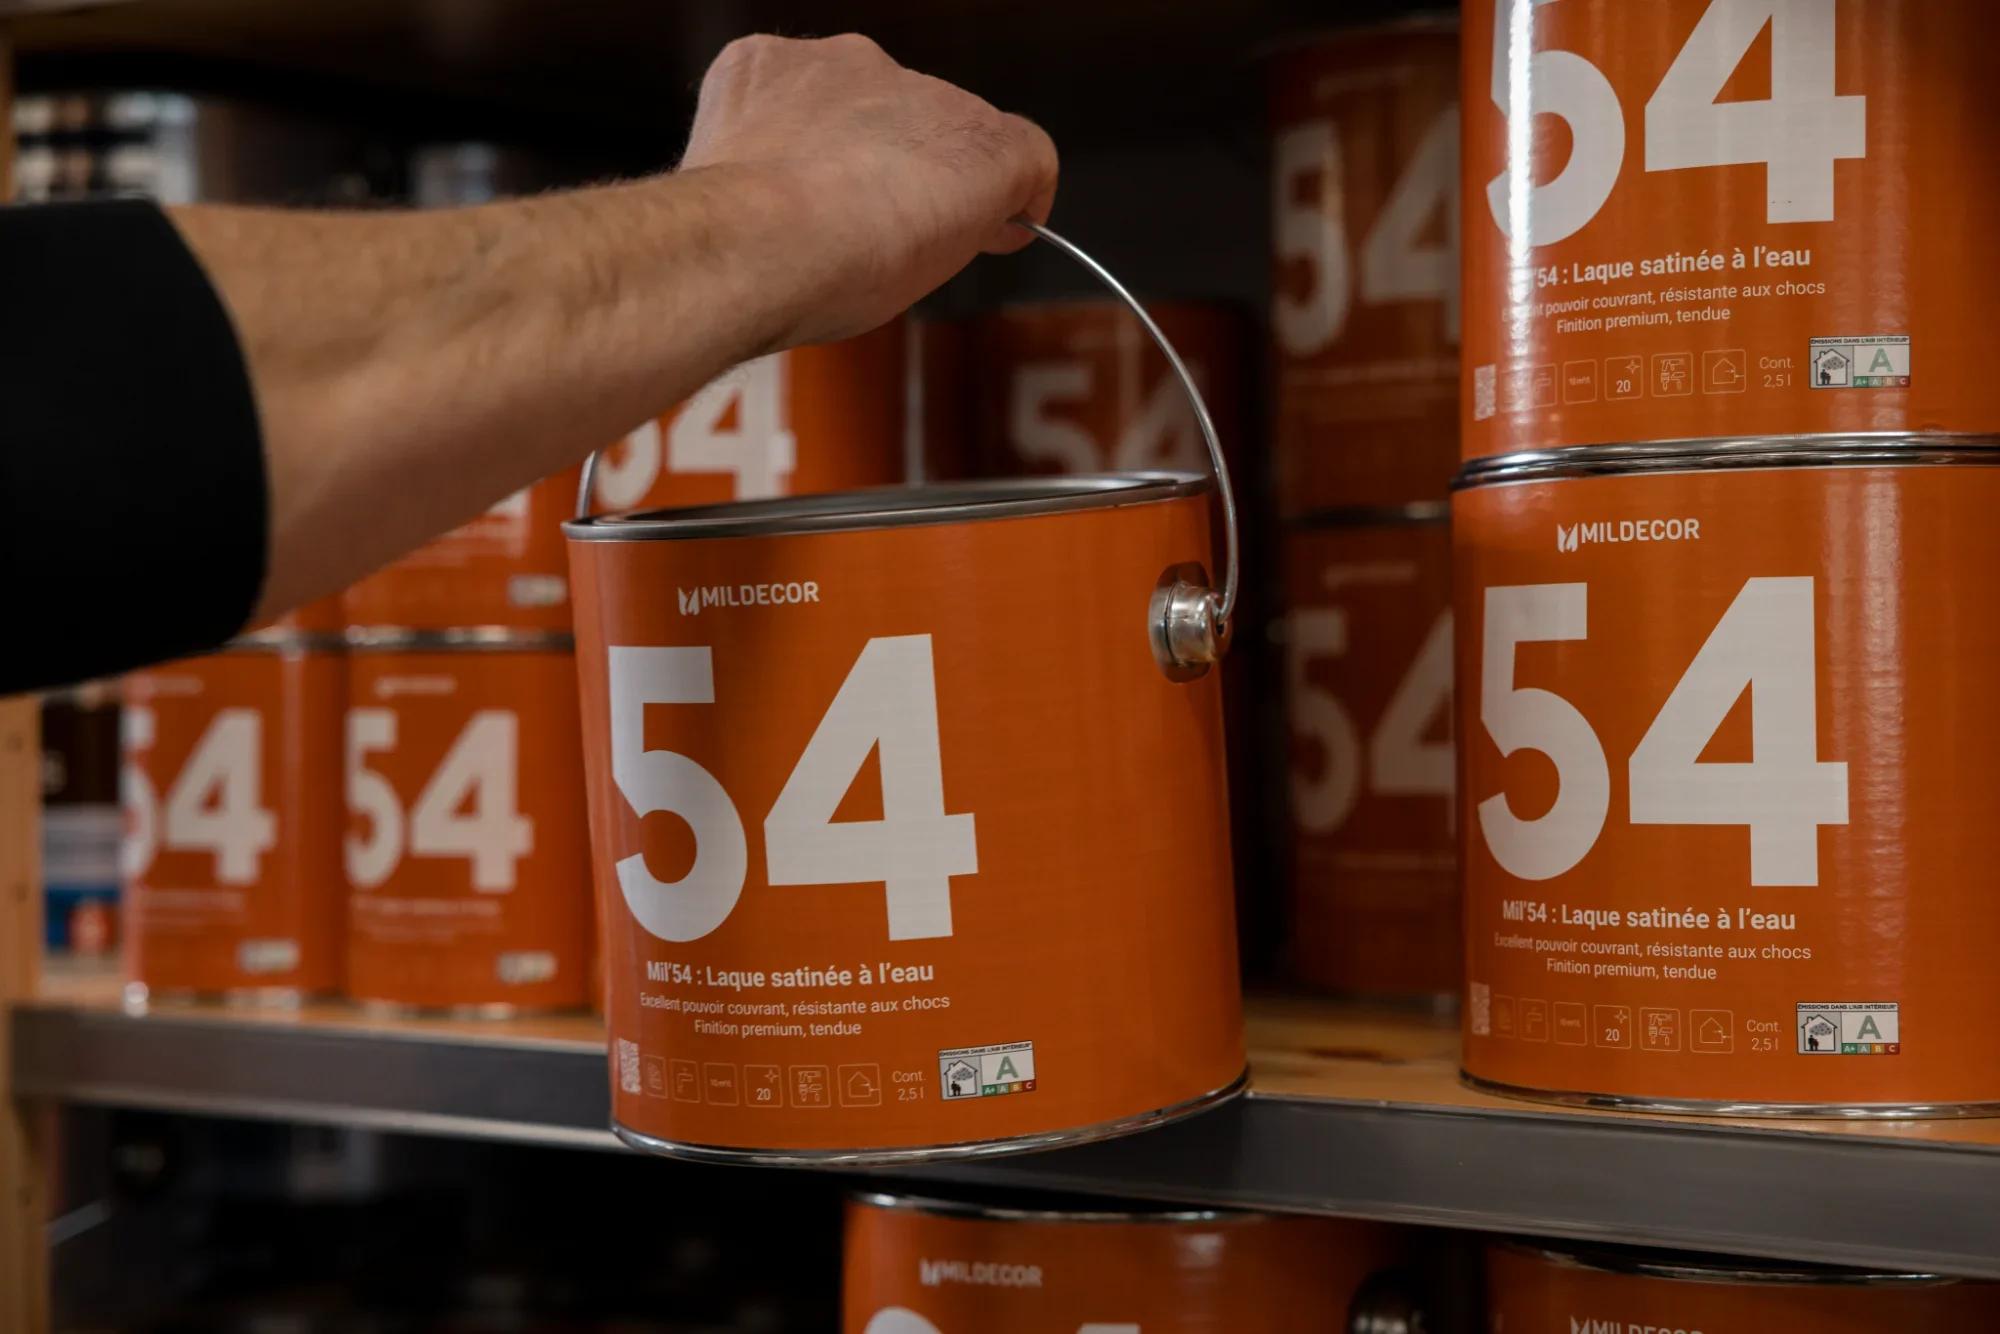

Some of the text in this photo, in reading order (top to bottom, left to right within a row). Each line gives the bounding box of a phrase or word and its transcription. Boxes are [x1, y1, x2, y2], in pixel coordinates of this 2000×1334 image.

[1486, 0, 1866, 247] 54
[1573, 260, 1633, 284] Laque
[1640, 250, 1724, 276] satinée
[1732, 248, 1745, 269] à
[1754, 246, 1810, 267] l'eau
[1546, 297, 1589, 318] pouvoir
[1593, 291, 1656, 309] couvrant,
[1660, 285, 1737, 302] résistante
[1742, 284, 1771, 297] aux
[1776, 280, 1825, 296] chocs
[1557, 307, 1731, 333] Finition premium, tendue
[1759, 357, 1795, 369] Cont.
[1868, 348, 1894, 373] A
[1616, 380, 1631, 393] 20
[1855, 378, 1867, 386] A+
[1581, 519, 1700, 543] MILDECOR
[701, 581, 820, 607] MILDECOR
[1478, 576, 1849, 887] 54
[345, 707, 535, 893] 54
[608, 633, 979, 942] 54
[1502, 900, 1547, 923] Mil'54
[1561, 904, 1620, 931] Laque
[1627, 906, 1710, 929] satinée
[1717, 908, 1731, 929] à
[1738, 908, 1796, 930] l'eau
[1494, 932, 1812, 960] Excellent pouvoir couvrant, résistante aux chocs
[647, 960, 692, 984] Mil'54
[707, 966, 765, 992] Laque
[771, 965, 852, 988] satinée
[859, 966, 873, 985] à
[879, 963, 934, 983] l'eau
[1547, 958, 1717, 980] Finition premium, tendue
[640, 992, 950, 1017] Excellent pouvoir couvrant, résistante aux chocs
[695, 1020, 862, 1039] Finition premium, tendue
[1606, 1029, 1620, 1041] 20
[1746, 1020, 1782, 1032] Cont.
[1857, 1015, 1882, 1040] A
[892, 1071, 926, 1083] Cont.
[996, 1056, 1019, 1080] A
[756, 1088, 771, 1101] 20
[984, 1086, 996, 1095] A+
